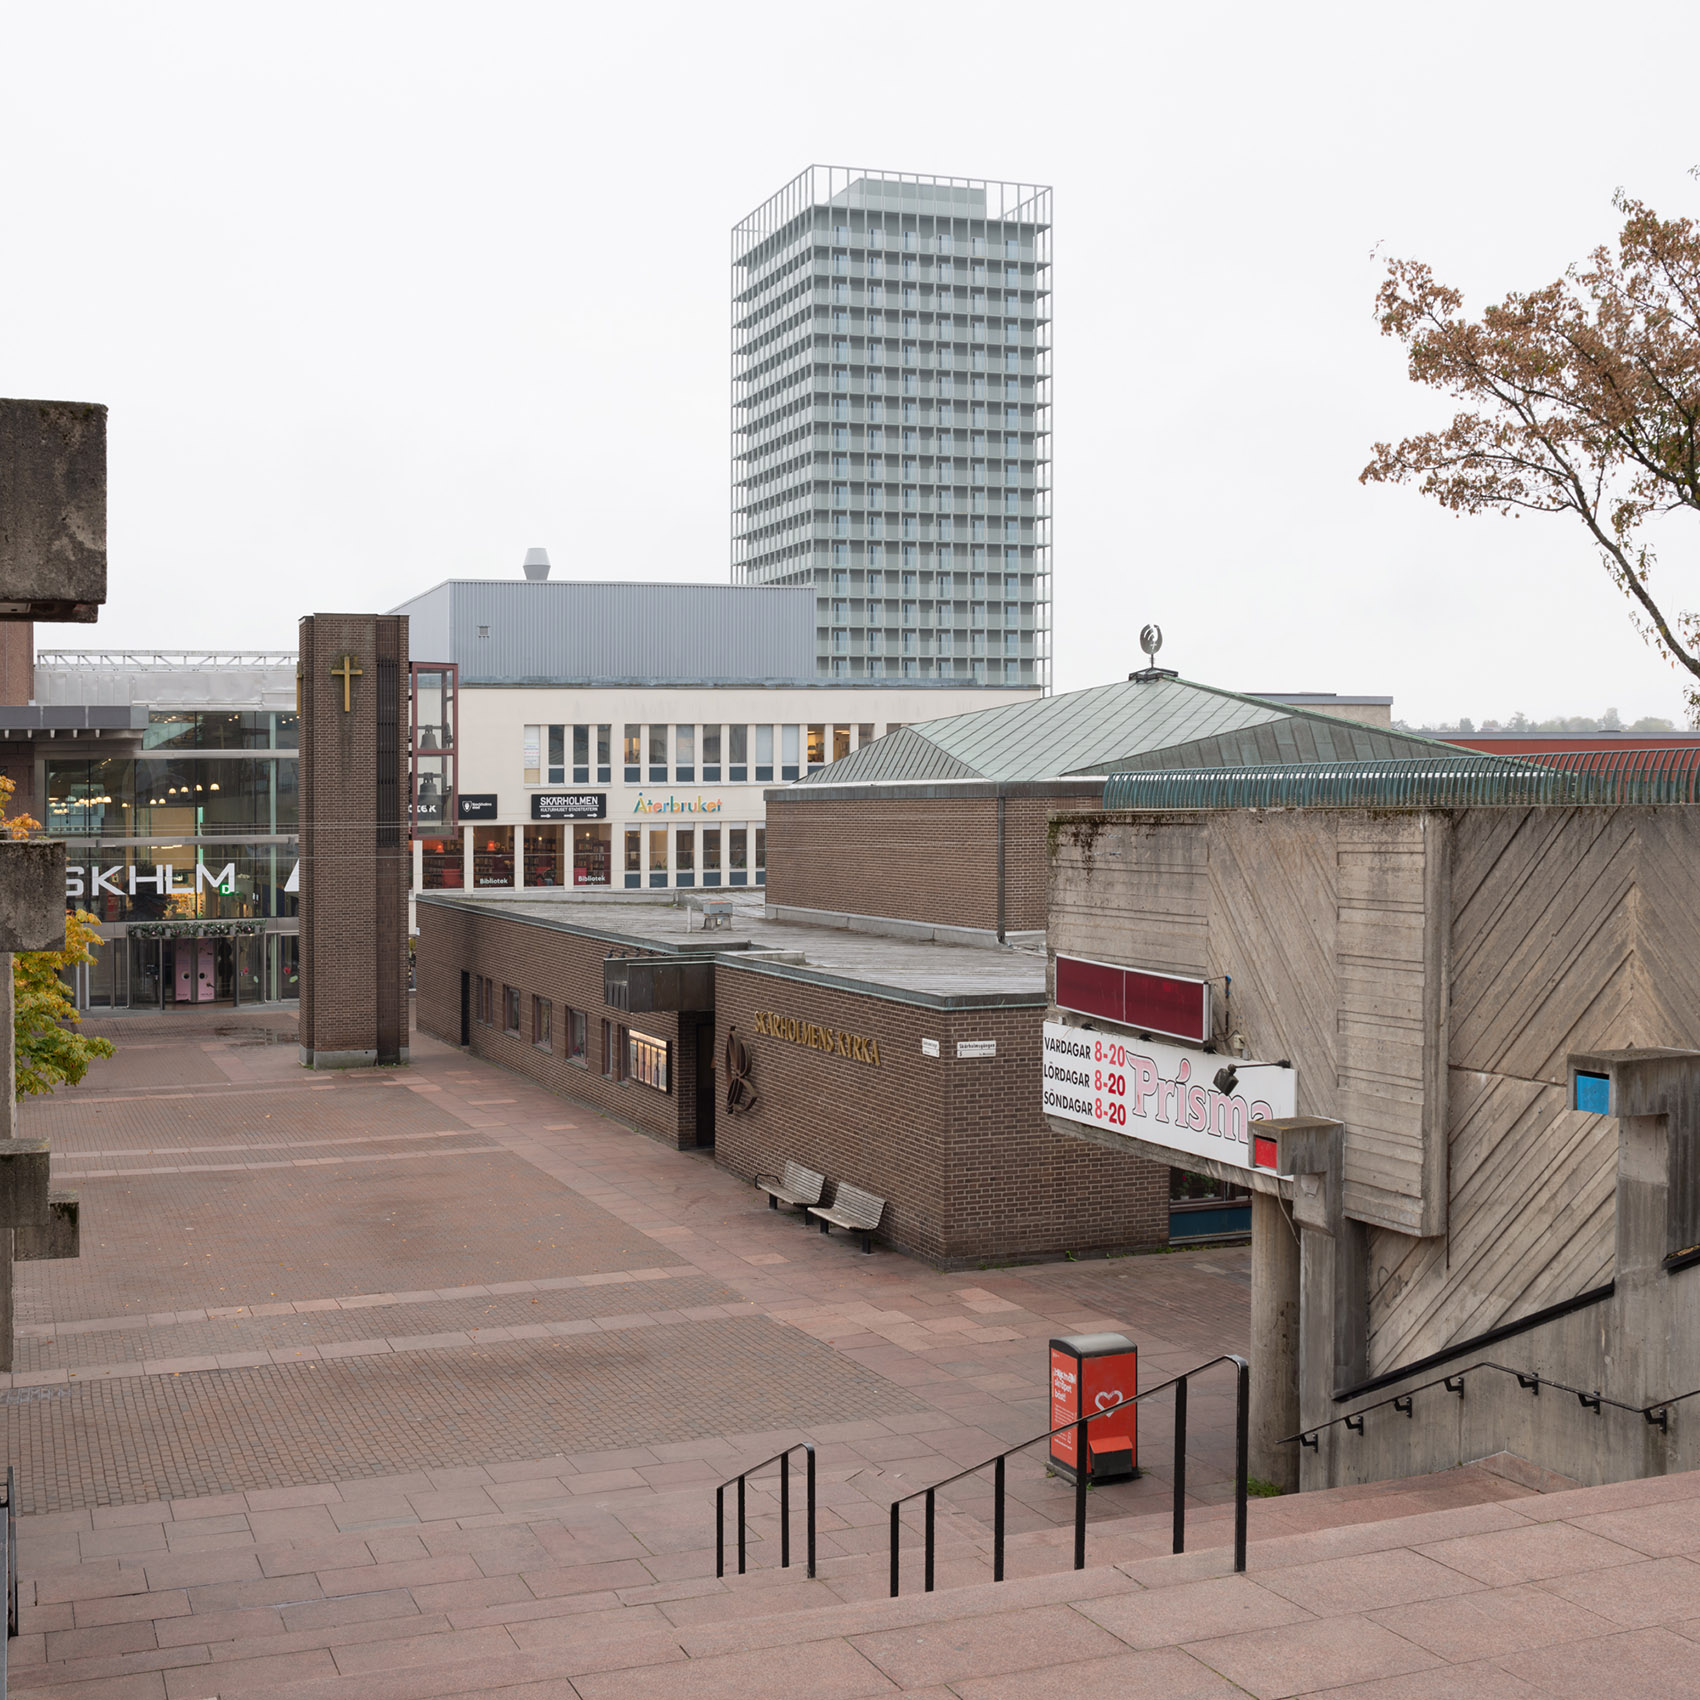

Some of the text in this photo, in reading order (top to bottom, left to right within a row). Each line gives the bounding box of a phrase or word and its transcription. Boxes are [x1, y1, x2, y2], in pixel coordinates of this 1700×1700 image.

[540, 796, 598, 806] SKÄRHOLMEN
[634, 792, 722, 813] Återbruket
[66, 862, 235, 896] SKHLM
[480, 877, 508, 885] Bibliotek
[578, 874, 606, 882] Bibliotek
[754, 1010, 880, 1066] SKÄRHOLMENS KYRKA
[1044, 1036, 1126, 1067] VARDAGAR 8-20
[1044, 1061, 1126, 1097] LÖRDAGAR 8-20
[1044, 1088, 1127, 1126] SÖNDAGAR 8-20
